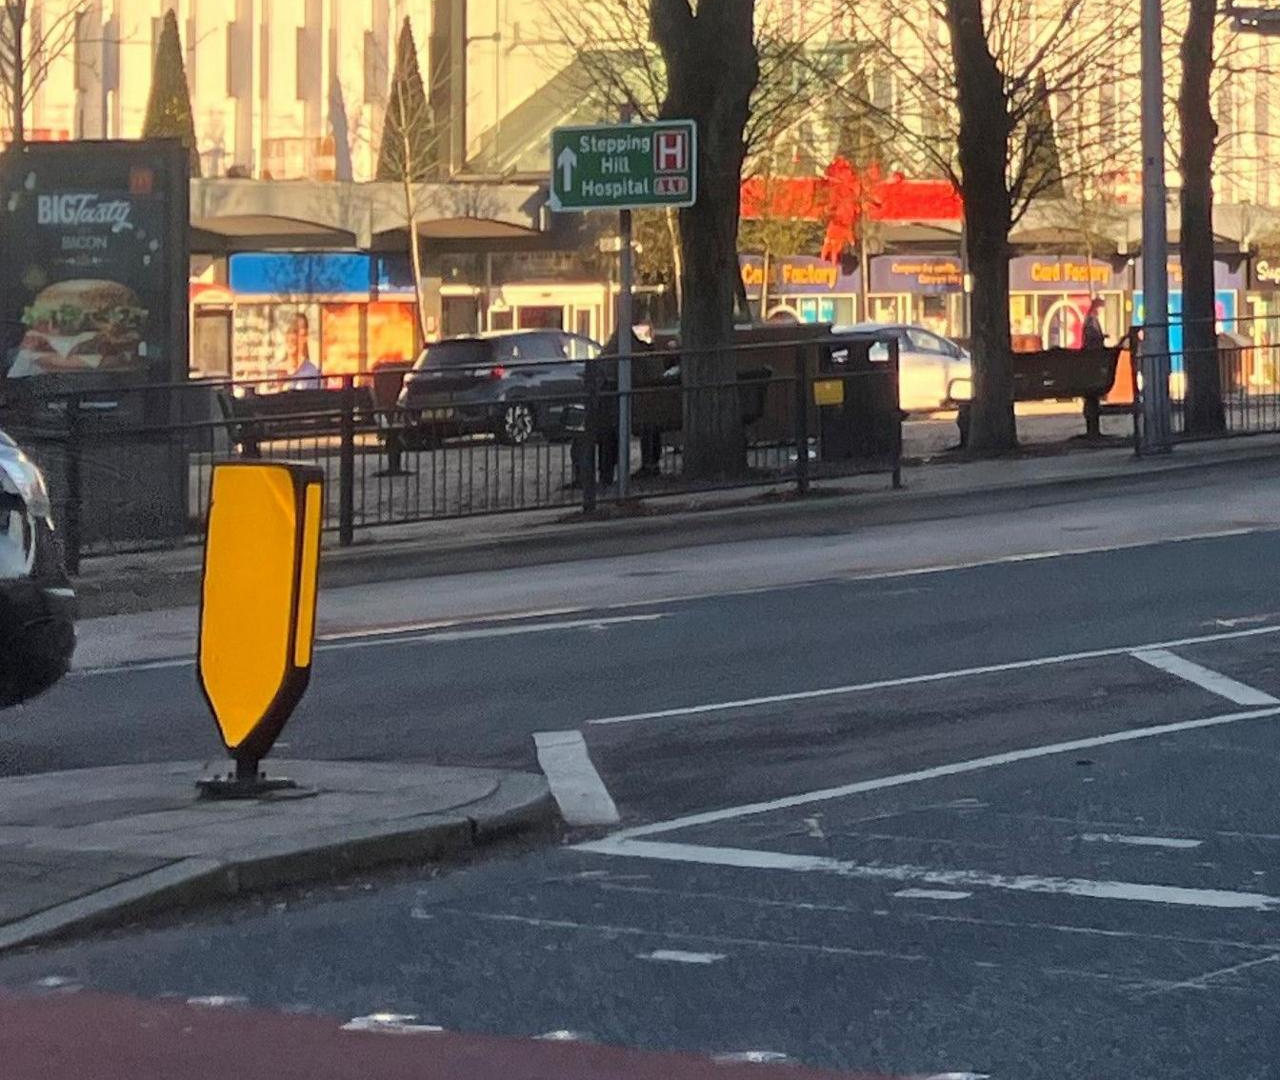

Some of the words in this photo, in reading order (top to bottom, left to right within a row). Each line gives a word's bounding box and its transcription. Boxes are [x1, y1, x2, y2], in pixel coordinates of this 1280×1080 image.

[579, 134, 651, 154] Stepping
[658, 134, 683, 169] H
[601, 156, 631, 174] Hill
[581, 177, 650, 199] Hospital
[782, 263, 838, 289] Factory
[1064, 262, 1109, 285] Factory
